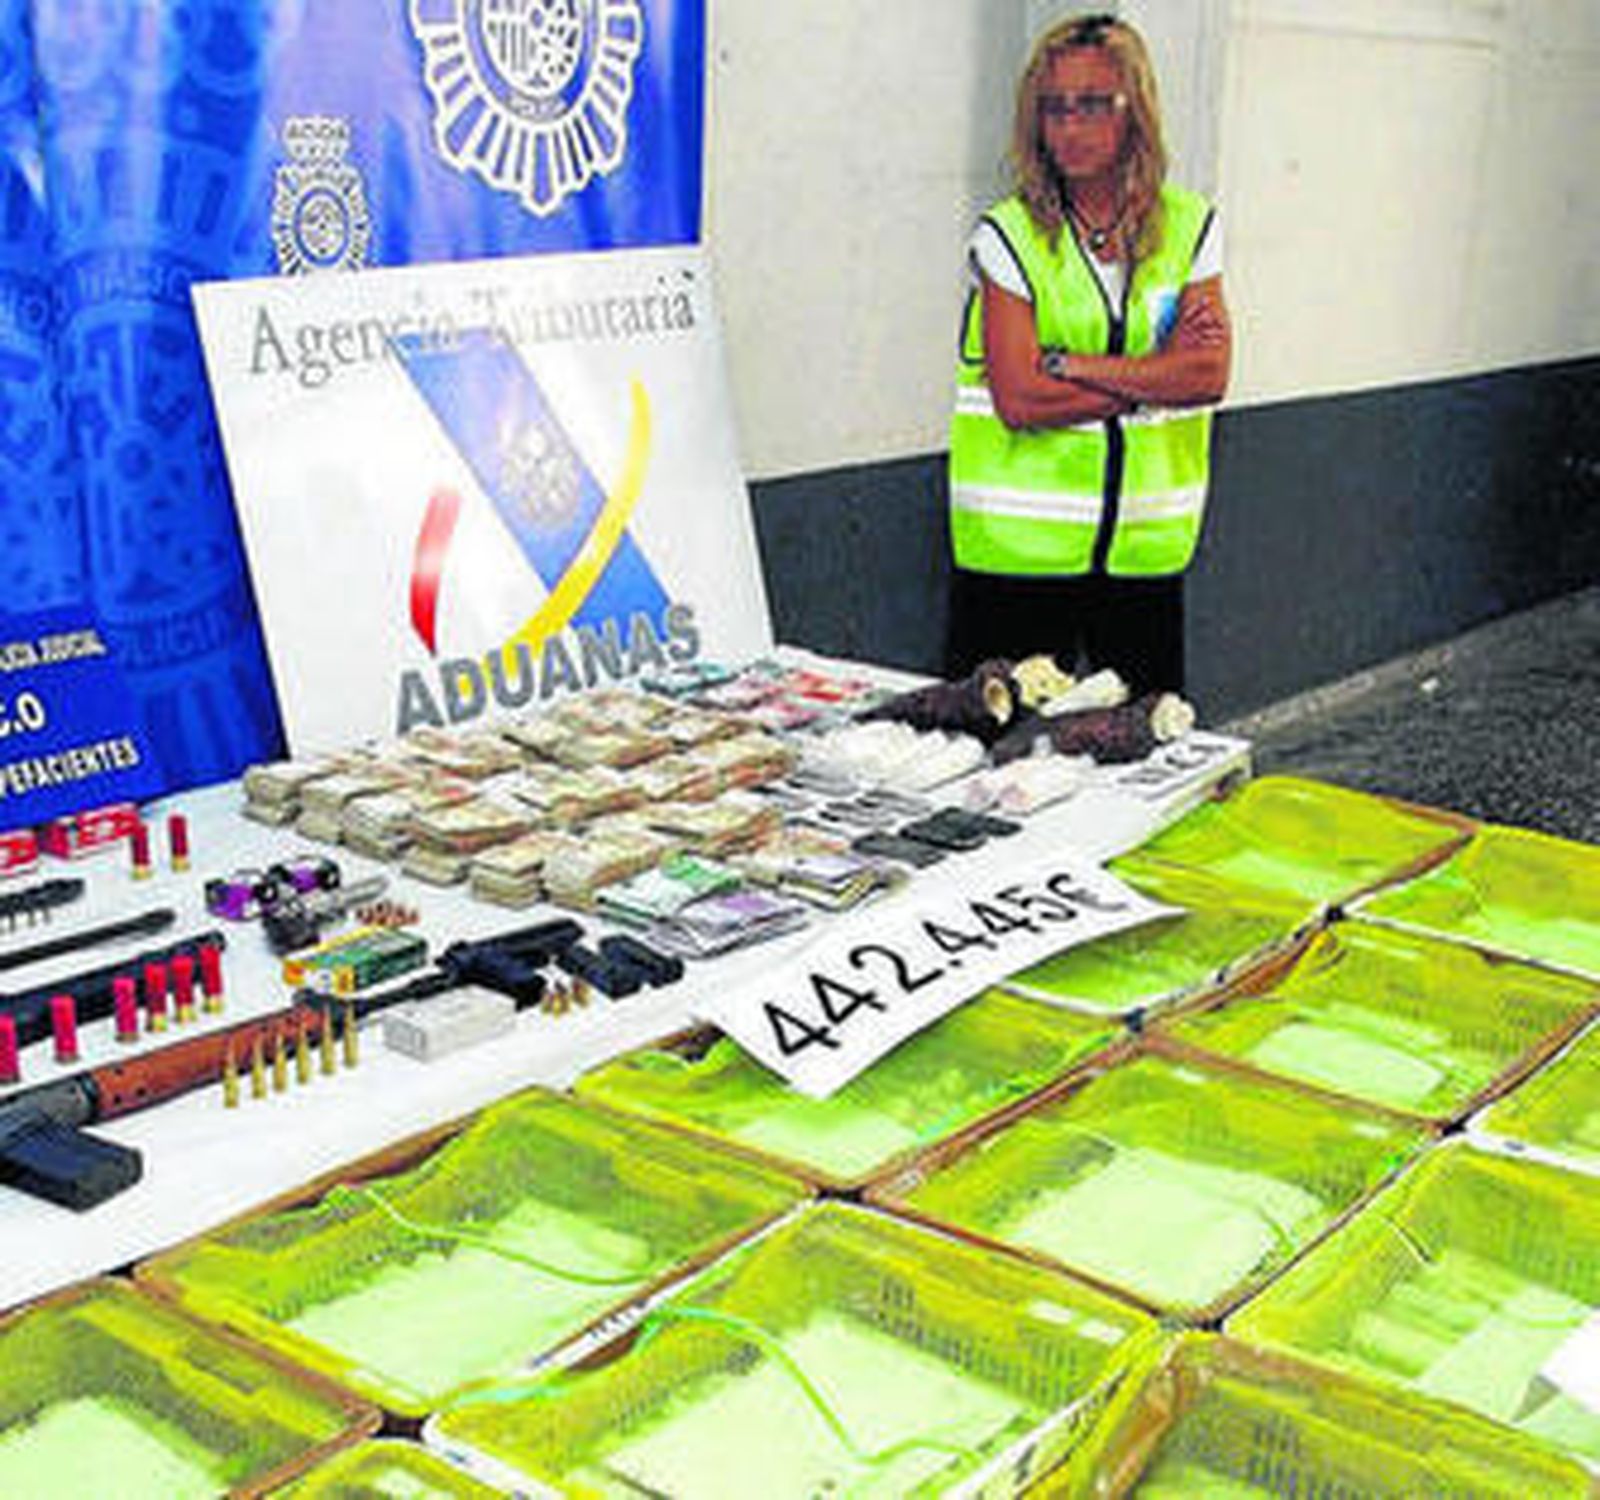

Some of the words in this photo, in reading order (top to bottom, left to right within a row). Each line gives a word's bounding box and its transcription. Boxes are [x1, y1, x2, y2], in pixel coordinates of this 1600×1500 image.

[250, 290, 456, 388] Agencia
[396, 603, 701, 737] ADUANAS
[762, 872, 1130, 1058] 442.445€
